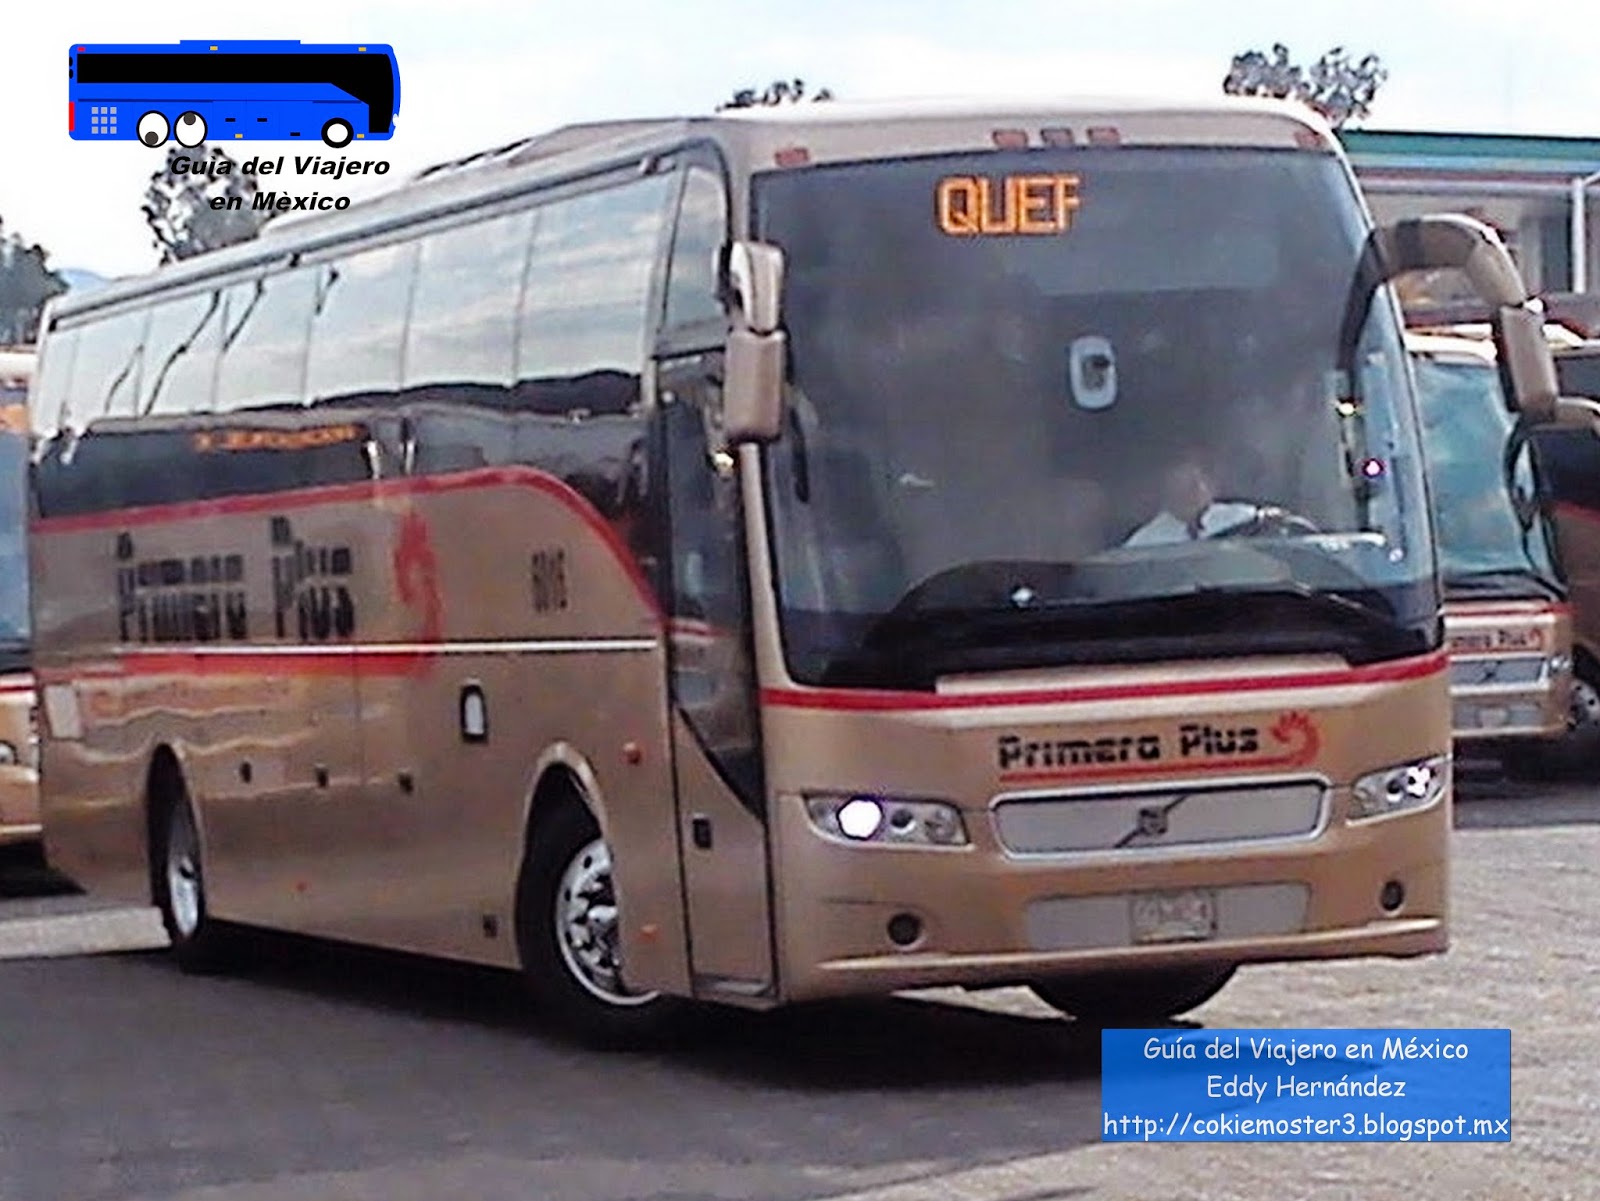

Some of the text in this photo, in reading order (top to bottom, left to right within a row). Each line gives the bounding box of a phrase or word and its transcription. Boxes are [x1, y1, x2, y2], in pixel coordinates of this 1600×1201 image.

[938, 175, 1080, 235] QUEF
[998, 724, 1259, 768] Primera Plus
